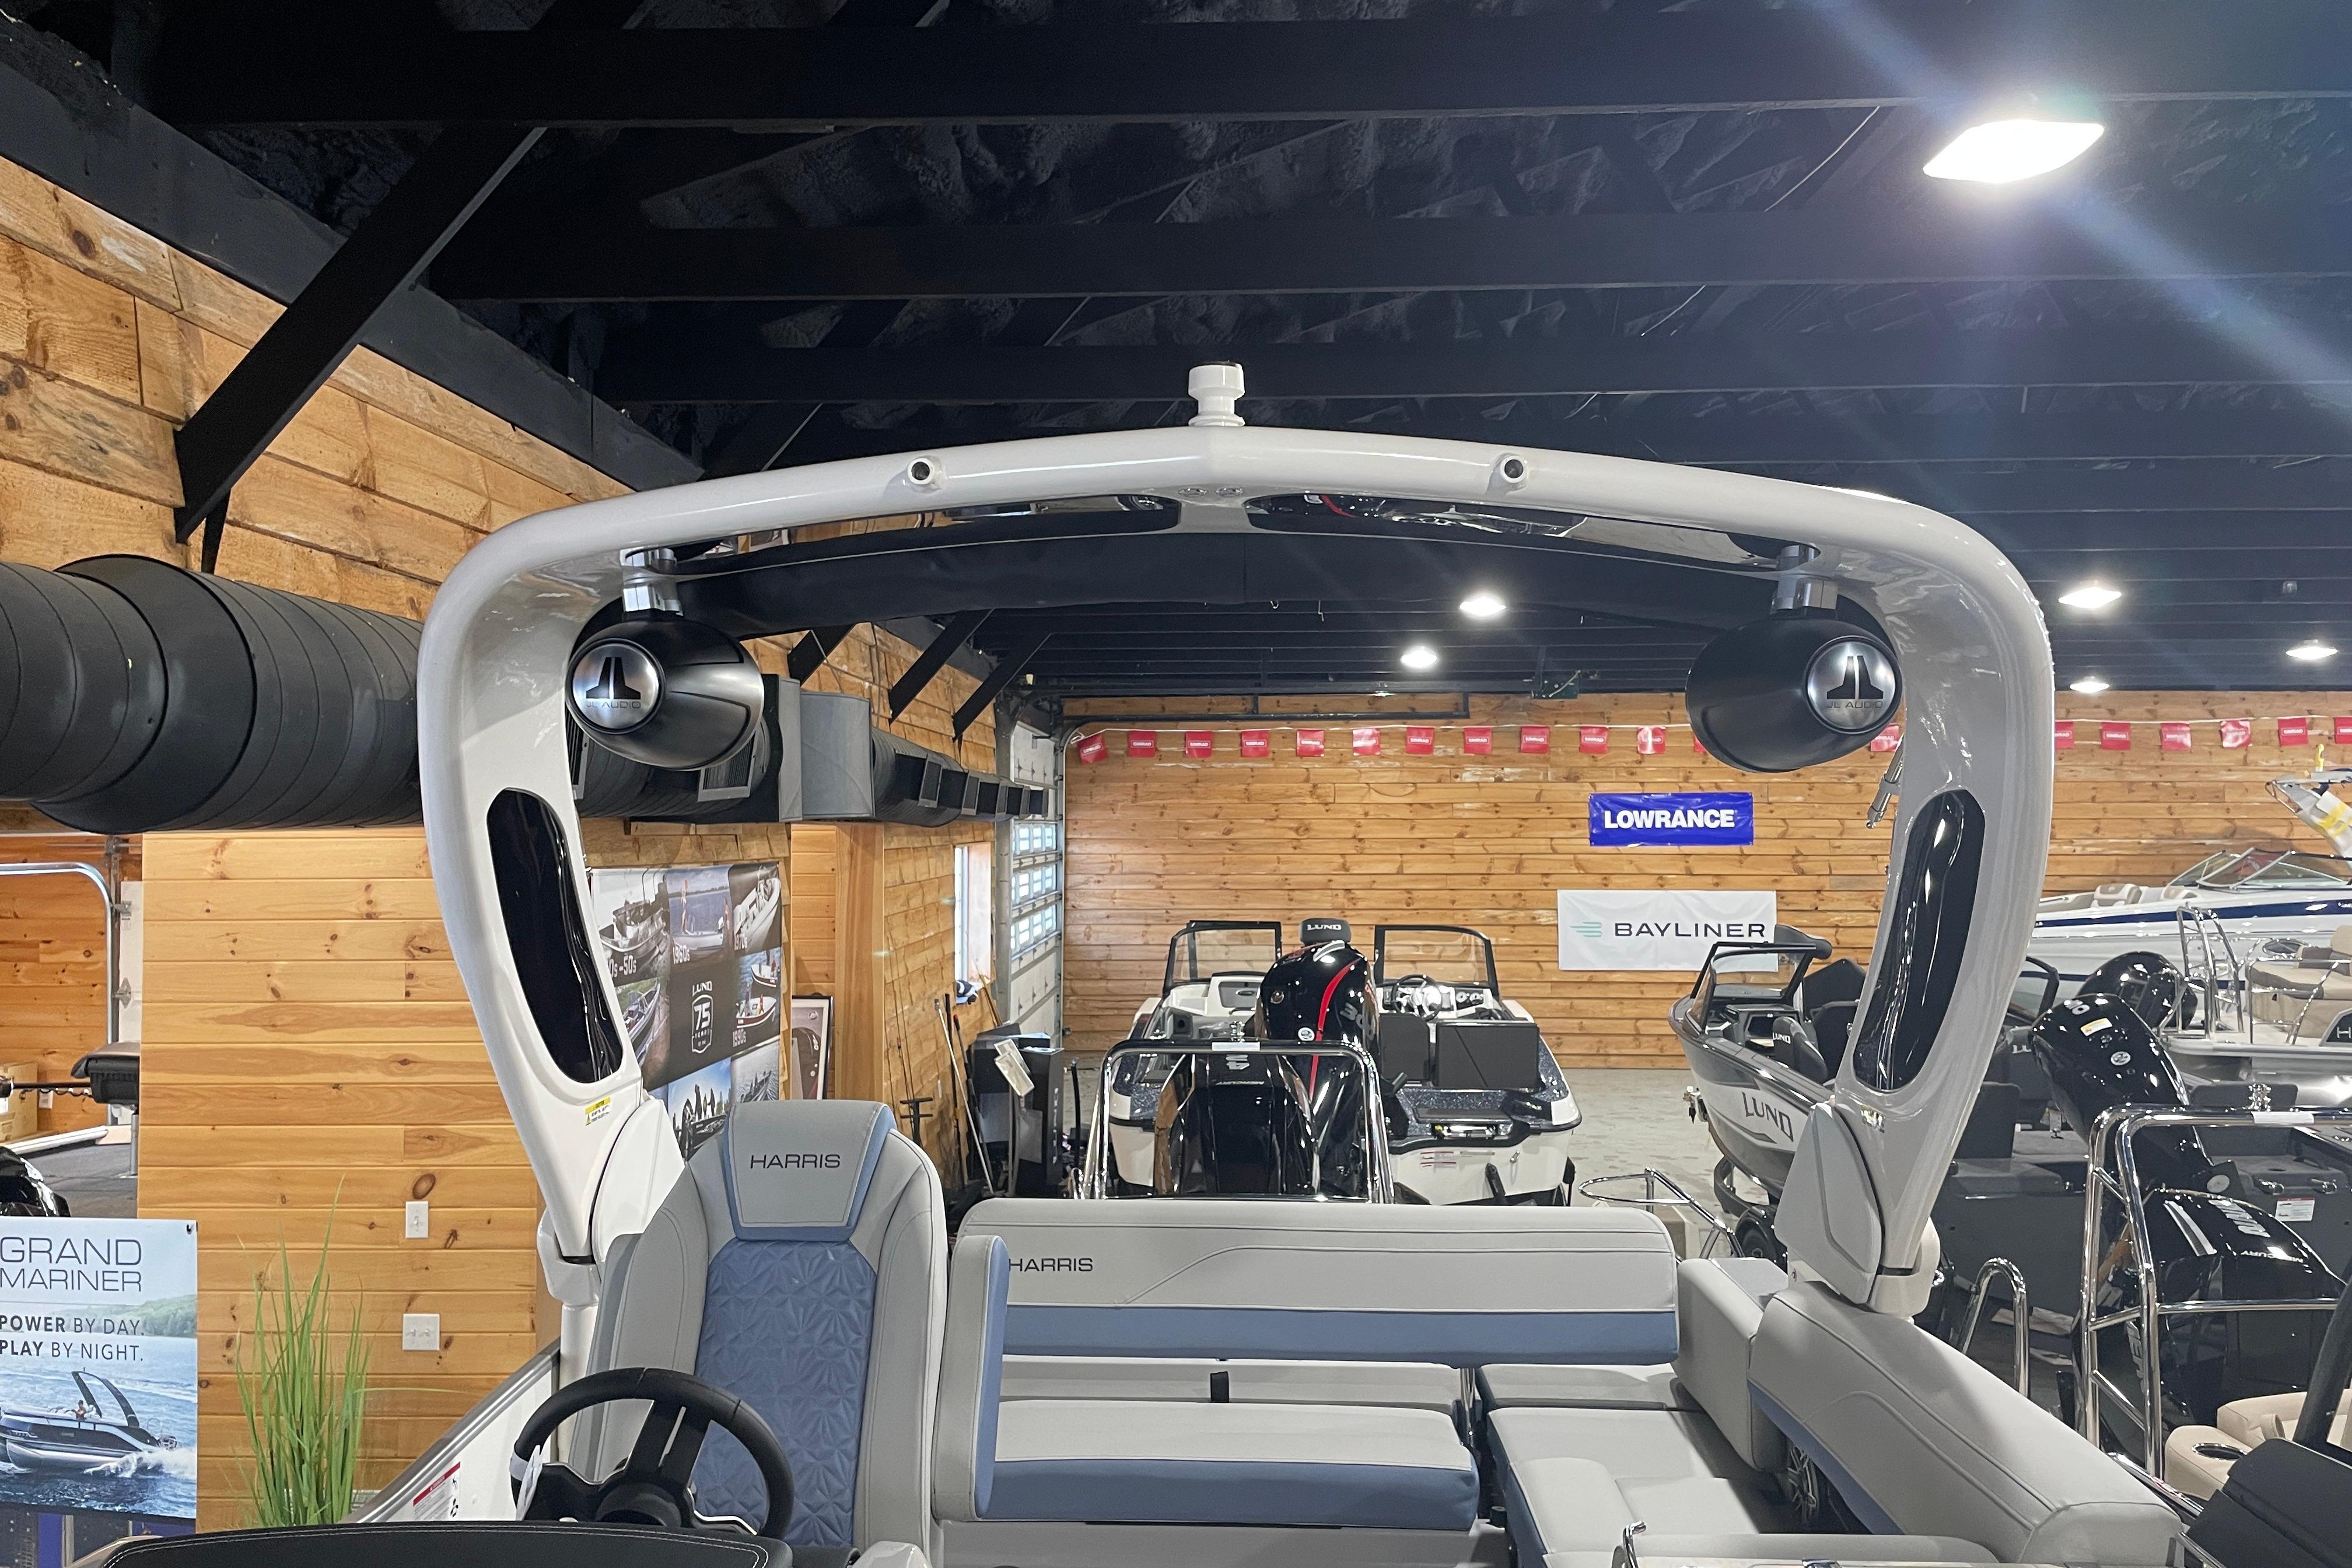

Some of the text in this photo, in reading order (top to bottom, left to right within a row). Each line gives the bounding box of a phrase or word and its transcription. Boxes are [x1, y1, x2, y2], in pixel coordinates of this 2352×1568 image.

[1604, 809, 1735, 828] LOWRANCE
[1614, 923, 1765, 937] BAYLINER
[692, 981, 712, 996] LUND
[694, 1002, 710, 1030] 75
[1773, 1032, 1791, 1044] LUND
[1741, 1091, 1794, 1143] LUND
[750, 1154, 841, 1169] HARRIS
[0, 1237, 141, 1265] GRAND
[1009, 1258, 1093, 1272] HARRIS
[0, 1268, 141, 1292] MARINER
[0, 1315, 144, 1336] POWER BY DAY.
[0, 1340, 144, 1362] PLAY BY NIGHT.
